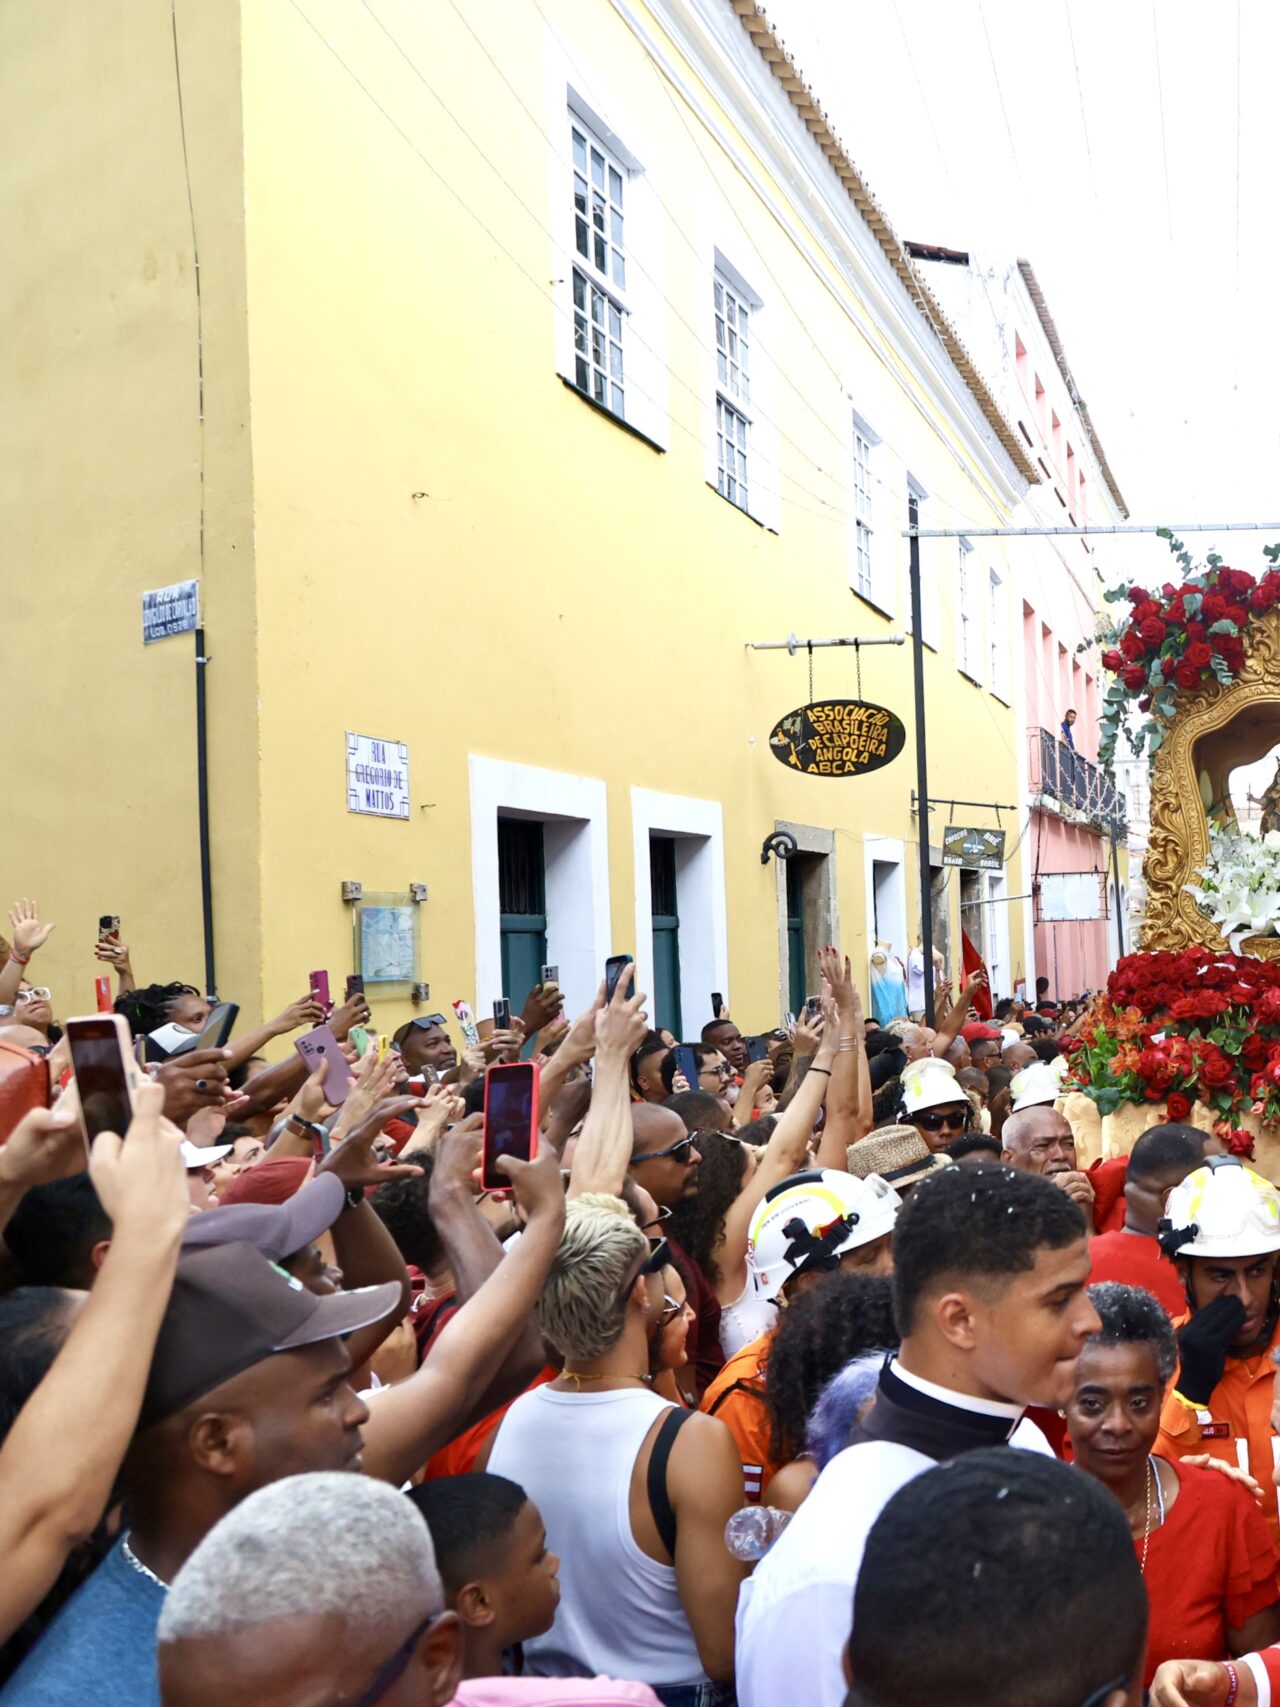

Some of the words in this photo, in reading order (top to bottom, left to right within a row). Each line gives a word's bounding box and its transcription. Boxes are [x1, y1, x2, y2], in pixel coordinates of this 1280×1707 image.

[813, 720, 888, 742] BRASILEIRA
[371, 741, 386, 764] RUA
[808, 736, 823, 750] DE
[822, 735, 886, 757] CAPOEIRA
[816, 748, 869, 764] ANGOLA
[355, 763, 392, 787] GREGORIO
[393, 770, 403, 789] DE
[807, 761, 856, 773] ABCA
[366, 787, 394, 810] MATTOS
